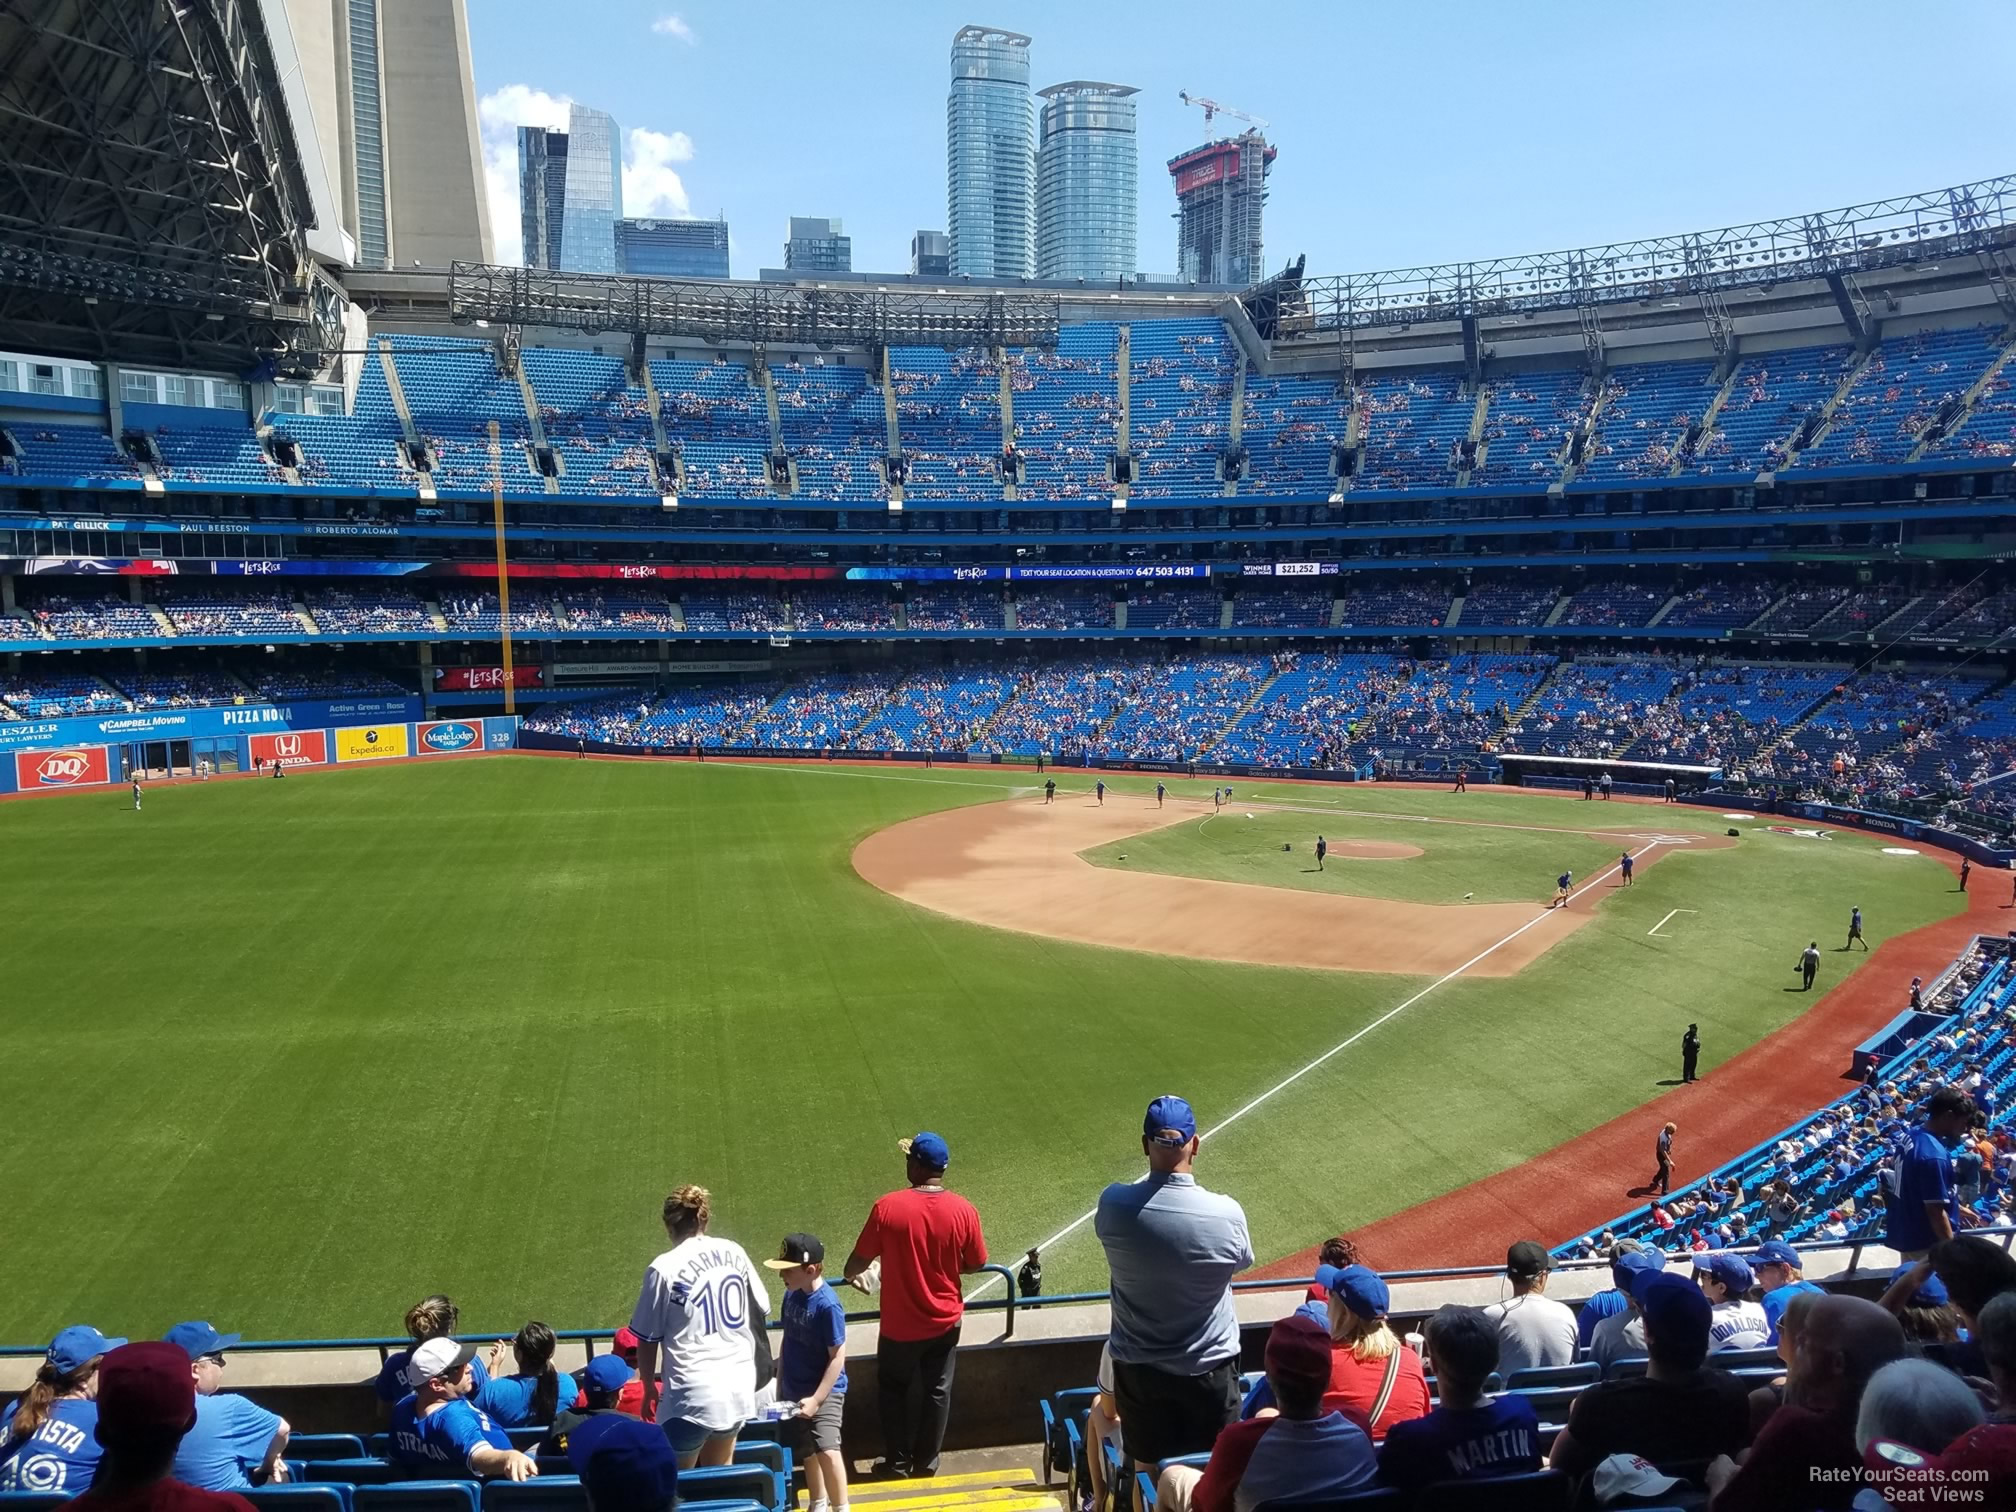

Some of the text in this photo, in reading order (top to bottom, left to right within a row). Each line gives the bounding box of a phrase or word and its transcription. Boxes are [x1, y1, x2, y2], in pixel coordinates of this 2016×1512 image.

[52, 520, 110, 531] PAT GILLICK
[180, 523, 250, 533] PAUL BEESTON
[315, 527, 358, 535] ROBERTO
[1020, 569, 1033, 577] TEXT
[1033, 569, 1050, 577] YOUR
[1050, 569, 1063, 577] SEAT
[1063, 569, 1092, 577] LOCATION
[1096, 568, 1125, 577] QUESTION
[1125, 568, 1134, 576] TO
[1135, 566, 1194, 577] 647 503 4131
[1281, 564, 1314, 575] $21,252
[329, 701, 406, 713] Active Green Ross
[223, 707, 294, 725] PIZZA NOVA
[107, 719, 152, 730] CAMPBELL
[152, 715, 187, 728] MOVING
[0, 724, 59, 737] ESZLER
[17, 733, 54, 742] LAWYERS
[491, 732, 510, 742] 328
[350, 744, 395, 757] Expedia.ca
[46, 757, 82, 777] DQ
[1864, 817, 1897, 830] HONDA
[691, 1273, 746, 1337] 10
[1710, 1318, 1769, 1343] DONALDSON
[1447, 1428, 1531, 1476] MARTIN
